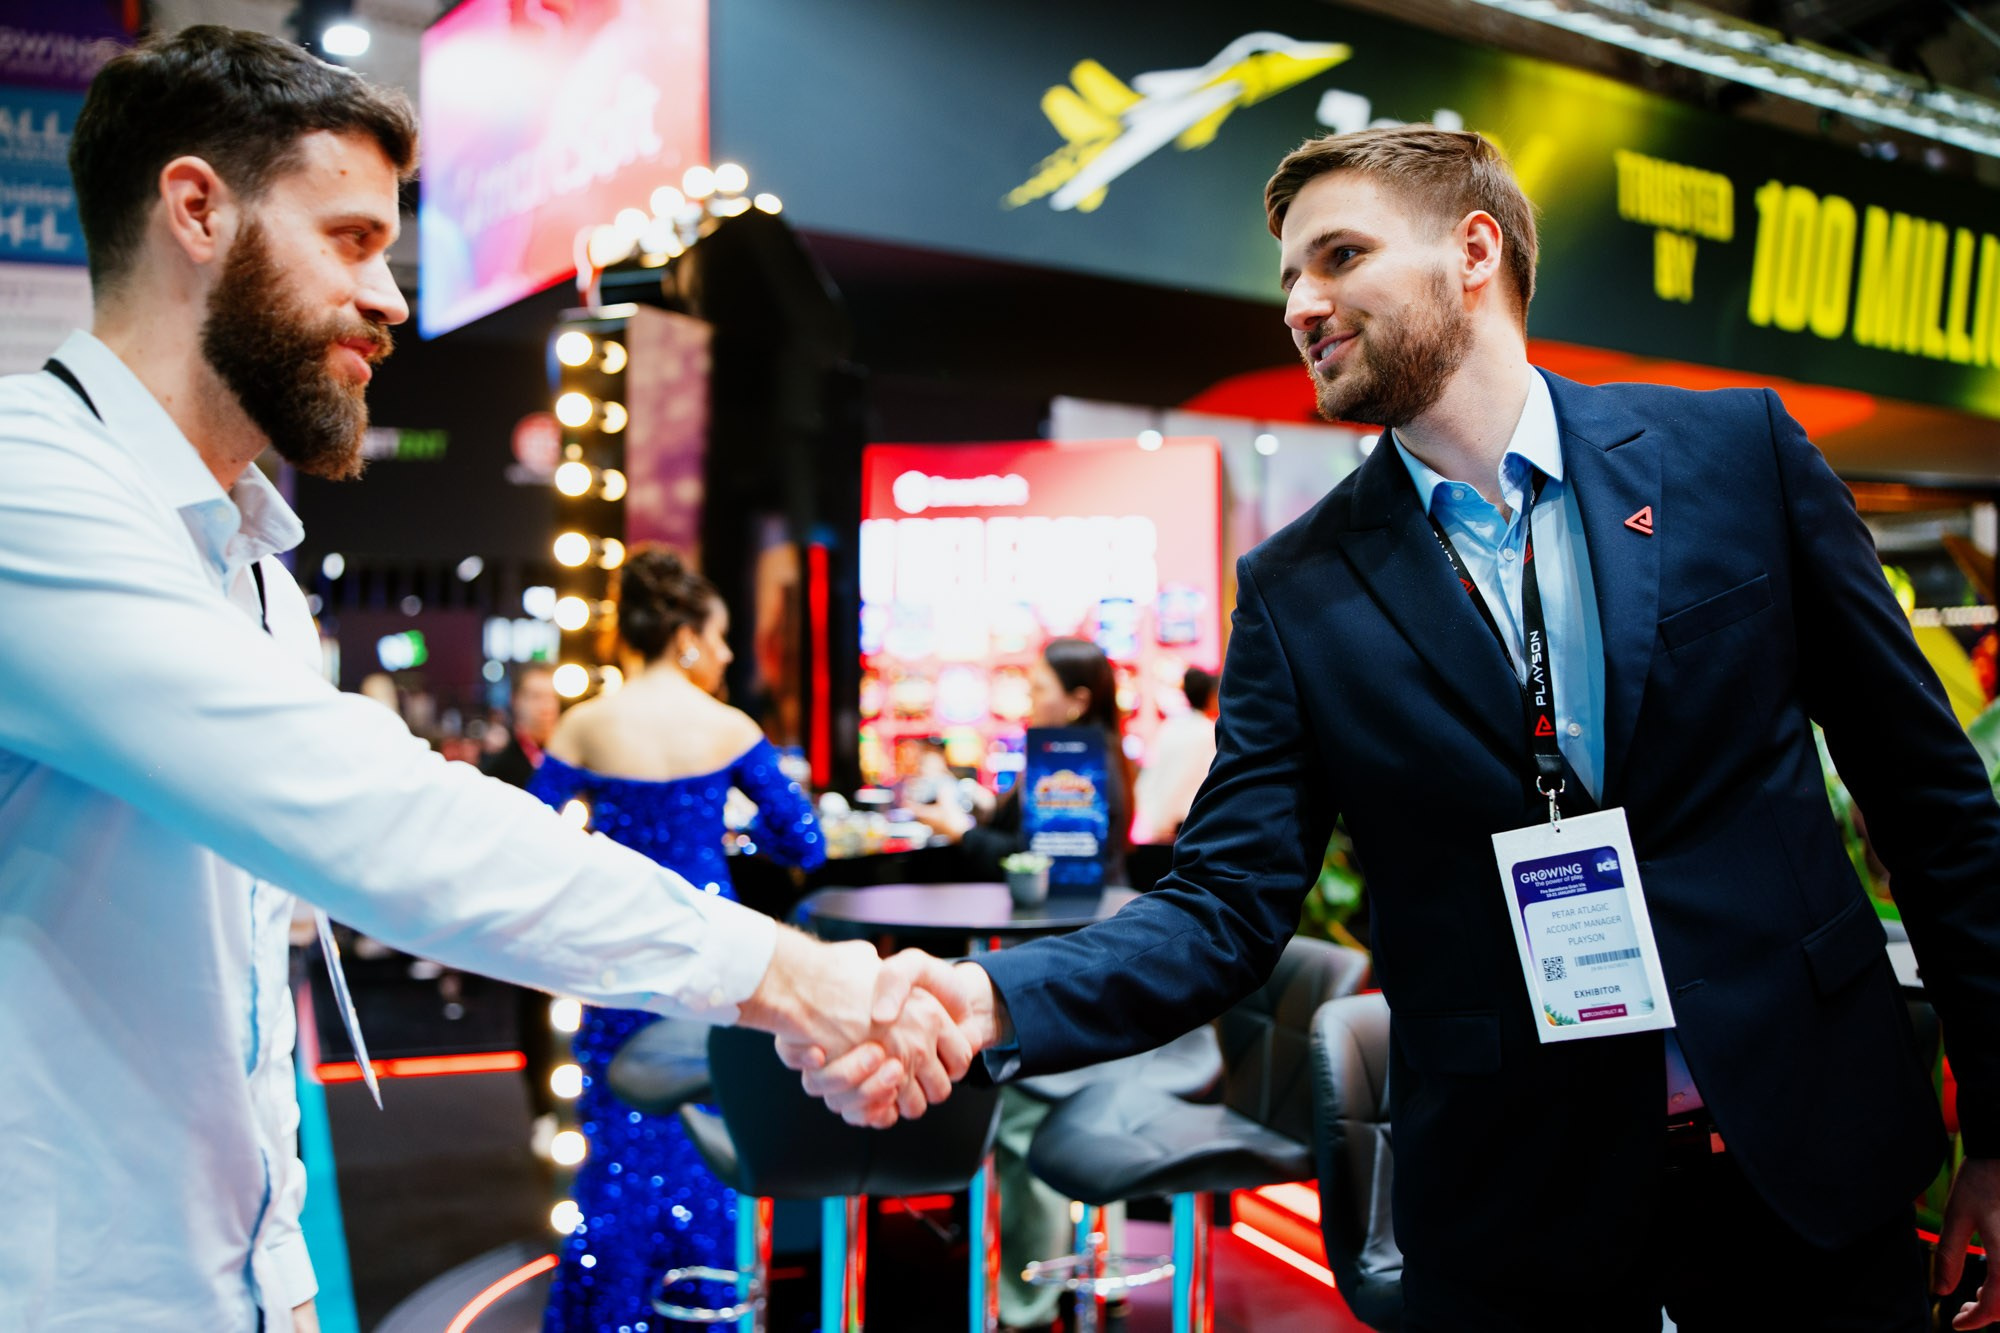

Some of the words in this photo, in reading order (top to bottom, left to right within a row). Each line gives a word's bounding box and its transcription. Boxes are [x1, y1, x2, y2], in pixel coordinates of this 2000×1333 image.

[1615, 149, 1734, 242] TRUSTED
[1653, 228, 1697, 304] BY
[1748, 179, 1858, 340] 100
[1530, 630, 1547, 706] PLAYSON
[1520, 863, 1583, 884] GROWING
[1596, 859, 1619, 873] ICE
[1545, 878, 1563, 887] power
[1551, 908, 1575, 919] PETAR
[1577, 902, 1609, 914] ATLAGIC
[1546, 921, 1581, 934] ACCOUNT
[1583, 915, 1622, 928] MANAGER
[1567, 932, 1605, 946] PLAYSON
[1573, 985, 1621, 999] EXHIBITOR
